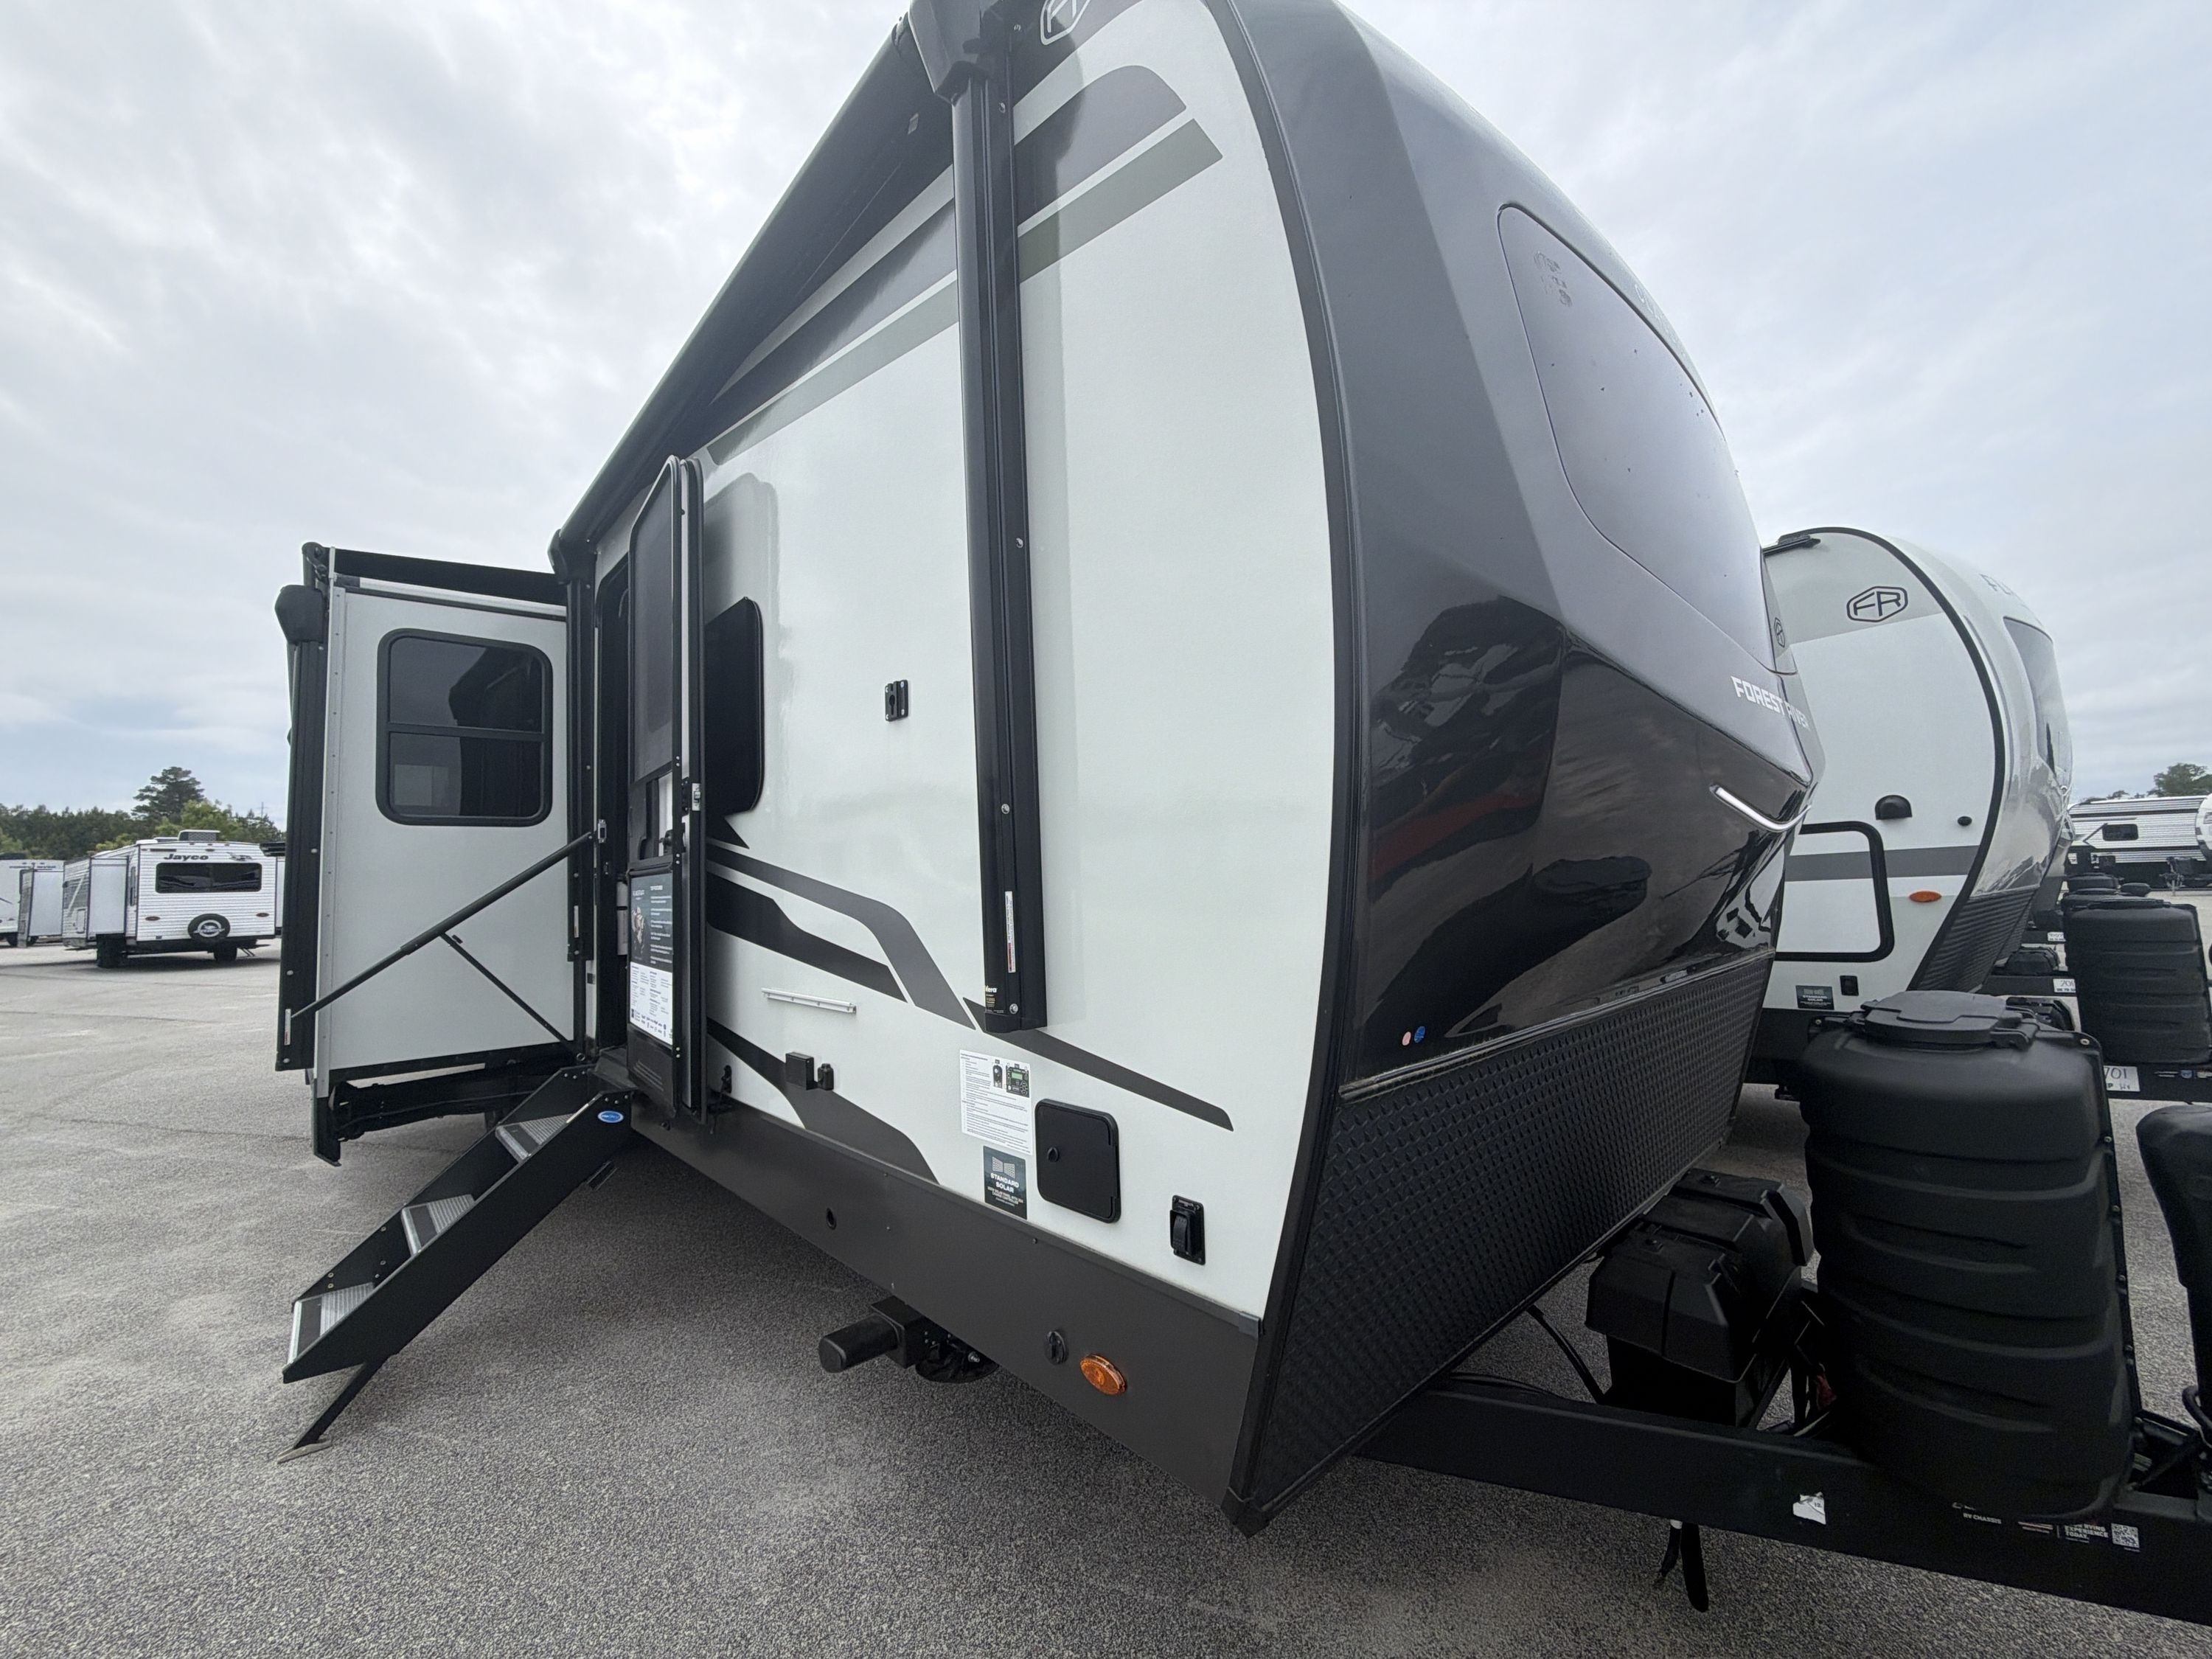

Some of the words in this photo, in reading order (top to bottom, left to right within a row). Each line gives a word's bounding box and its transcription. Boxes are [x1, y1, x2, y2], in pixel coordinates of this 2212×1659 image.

[1851, 589, 1902, 618] FR
[1731, 675, 1785, 716] FOREST
[164, 853, 209, 861] Jayco
[990, 1172, 1020, 1189] STANDARD
[995, 1181, 1015, 1194] SOLAR
